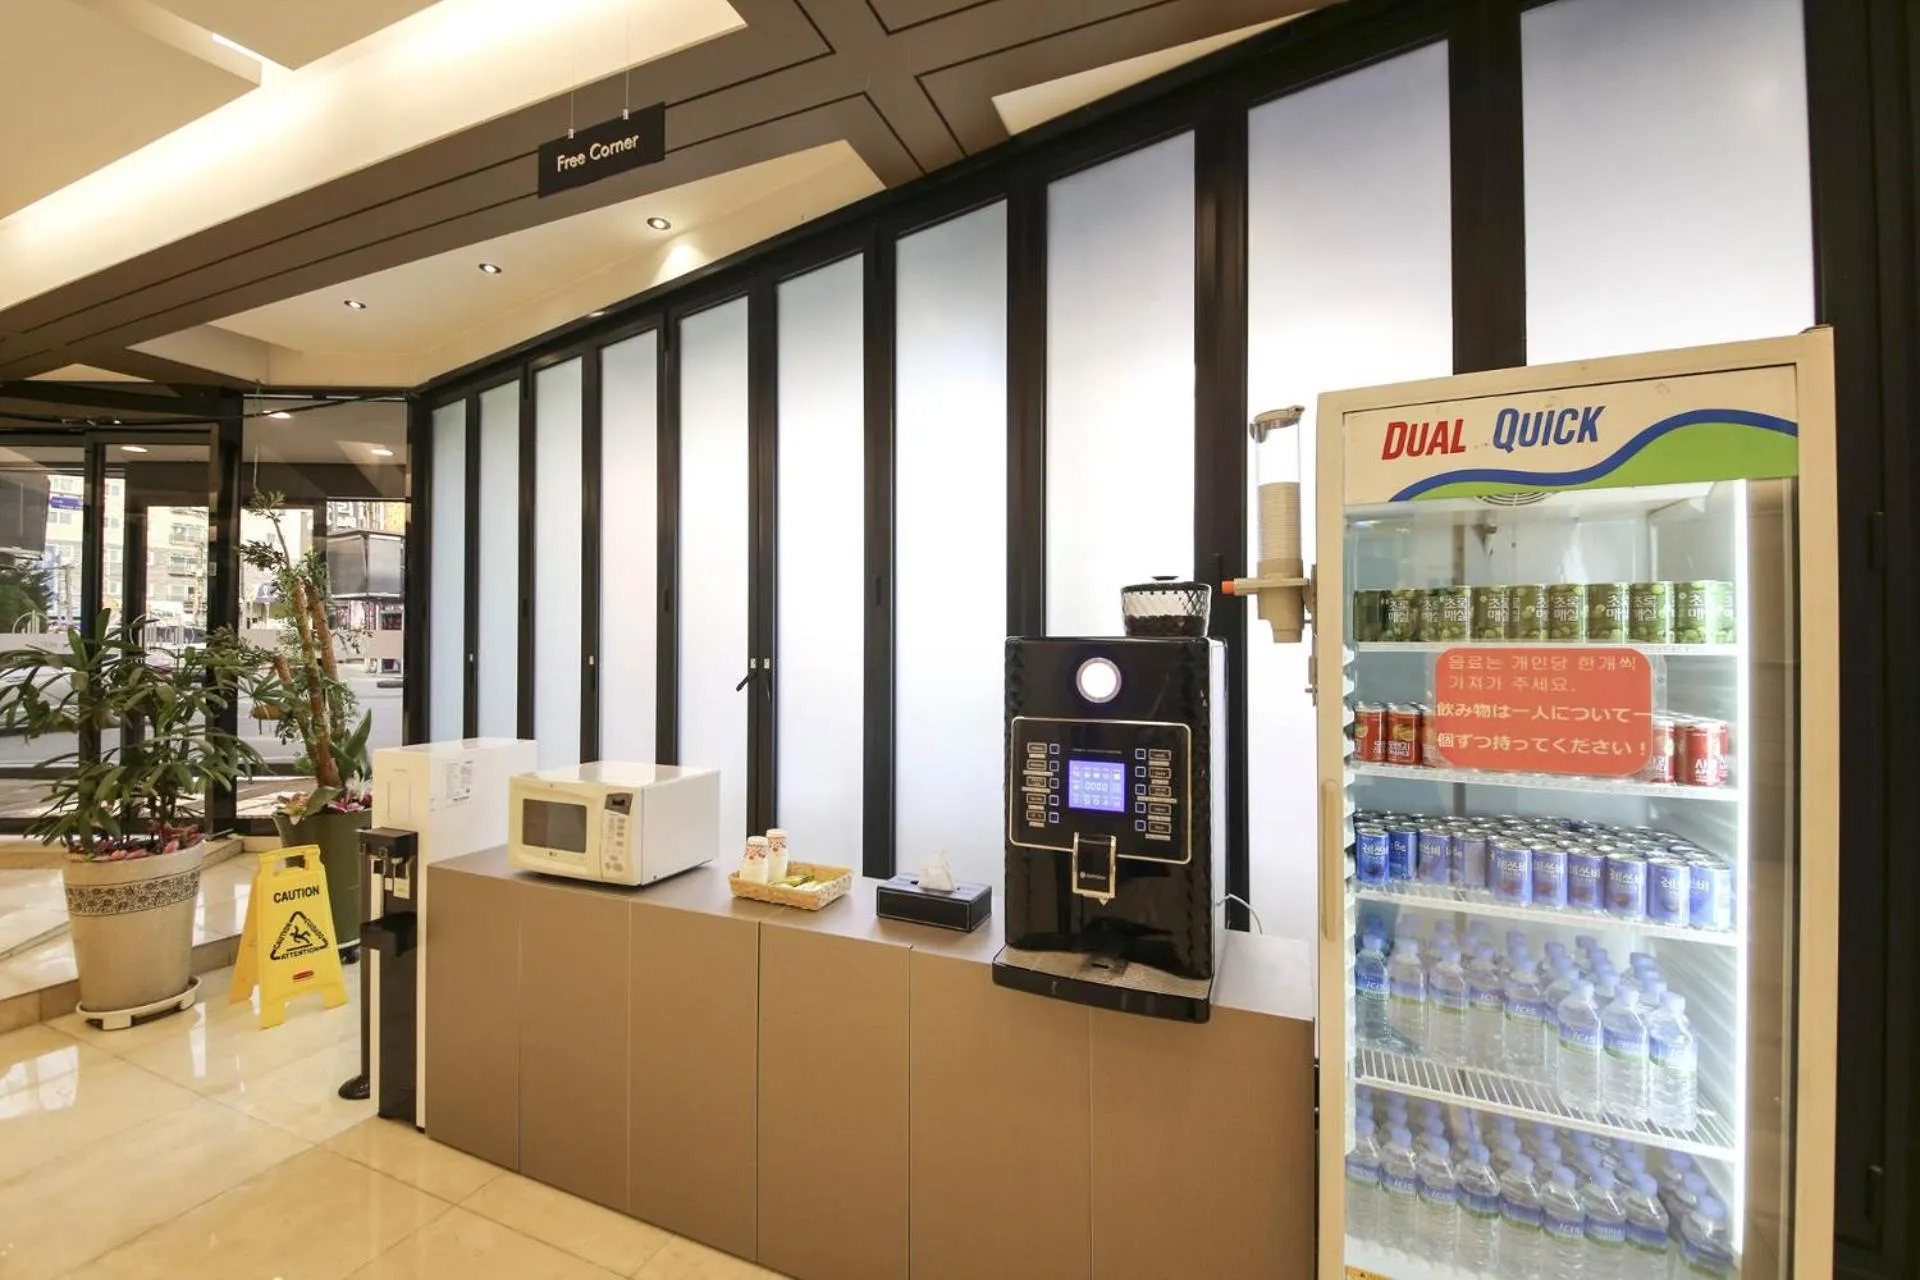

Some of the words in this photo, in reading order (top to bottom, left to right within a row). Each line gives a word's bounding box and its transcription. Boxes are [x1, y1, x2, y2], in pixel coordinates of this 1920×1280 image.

[557, 153, 586, 172] Free
[590, 135, 639, 160] Corner
[1382, 418, 1467, 460] DUAL
[1493, 405, 1606, 453] QUICK
[1448, 655, 1502, 671] 음료는
[1512, 655, 1567, 671] 개인당
[273, 885, 320, 903] CAUTION
